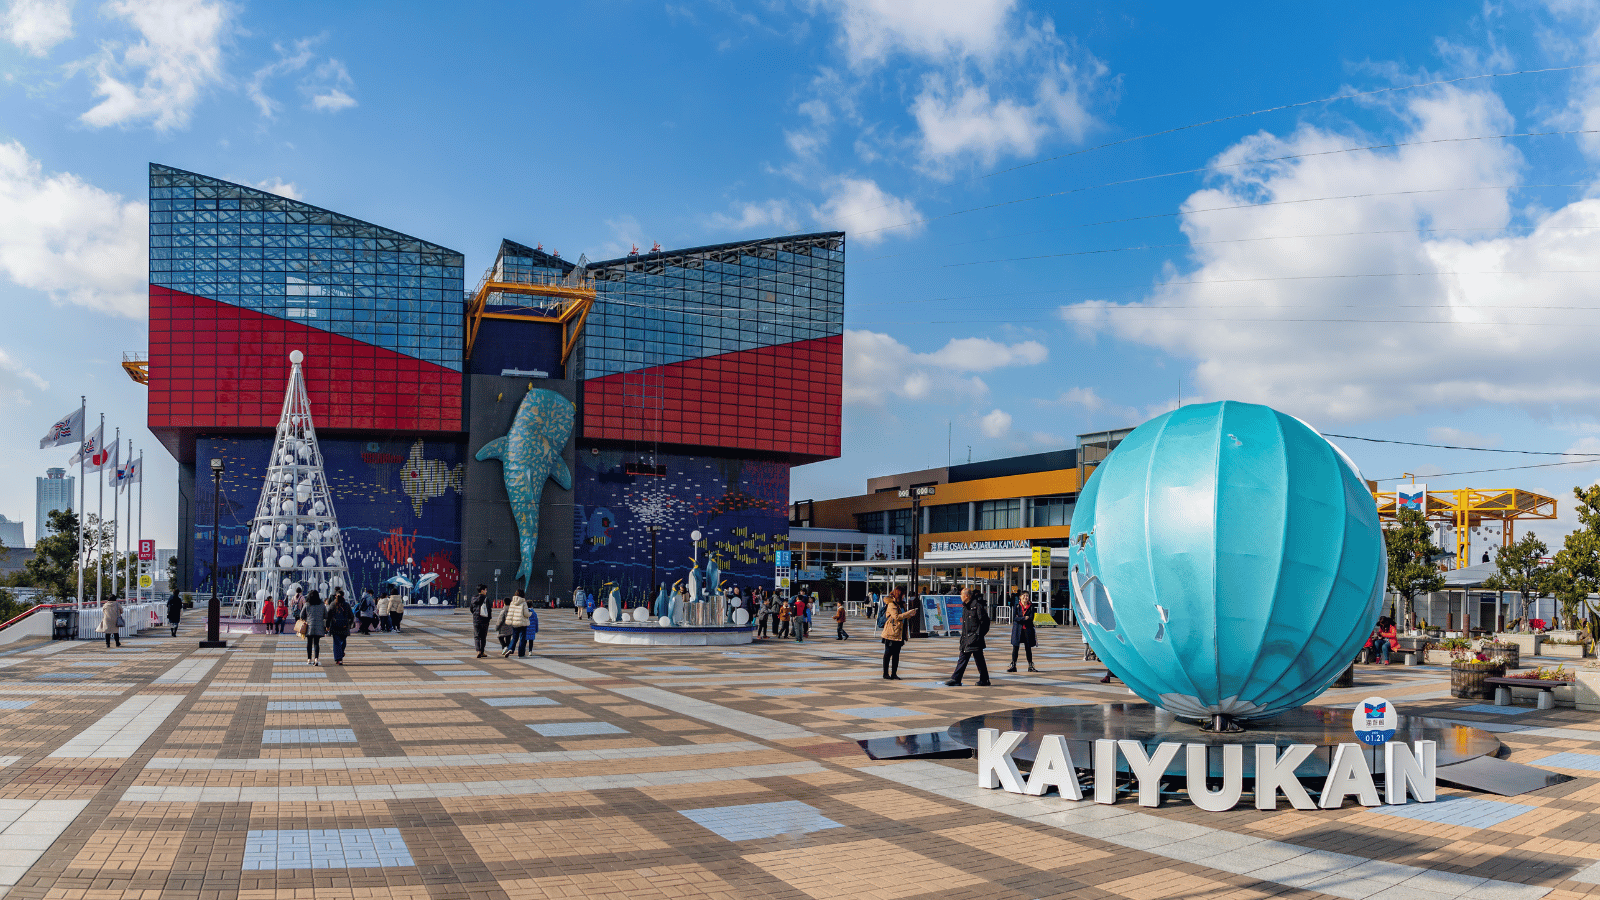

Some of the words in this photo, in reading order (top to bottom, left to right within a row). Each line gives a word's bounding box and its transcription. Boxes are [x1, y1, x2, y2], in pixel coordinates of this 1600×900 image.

[142, 542, 150, 552] B
[949, 542, 968, 551] OSAKA
[969, 541, 998, 550] AQUARIUM
[998, 539, 1031, 549] KAIYUKAN
[1365, 734, 1385, 742] 01.21
[978, 728, 1437, 812] KAIYUKAN
